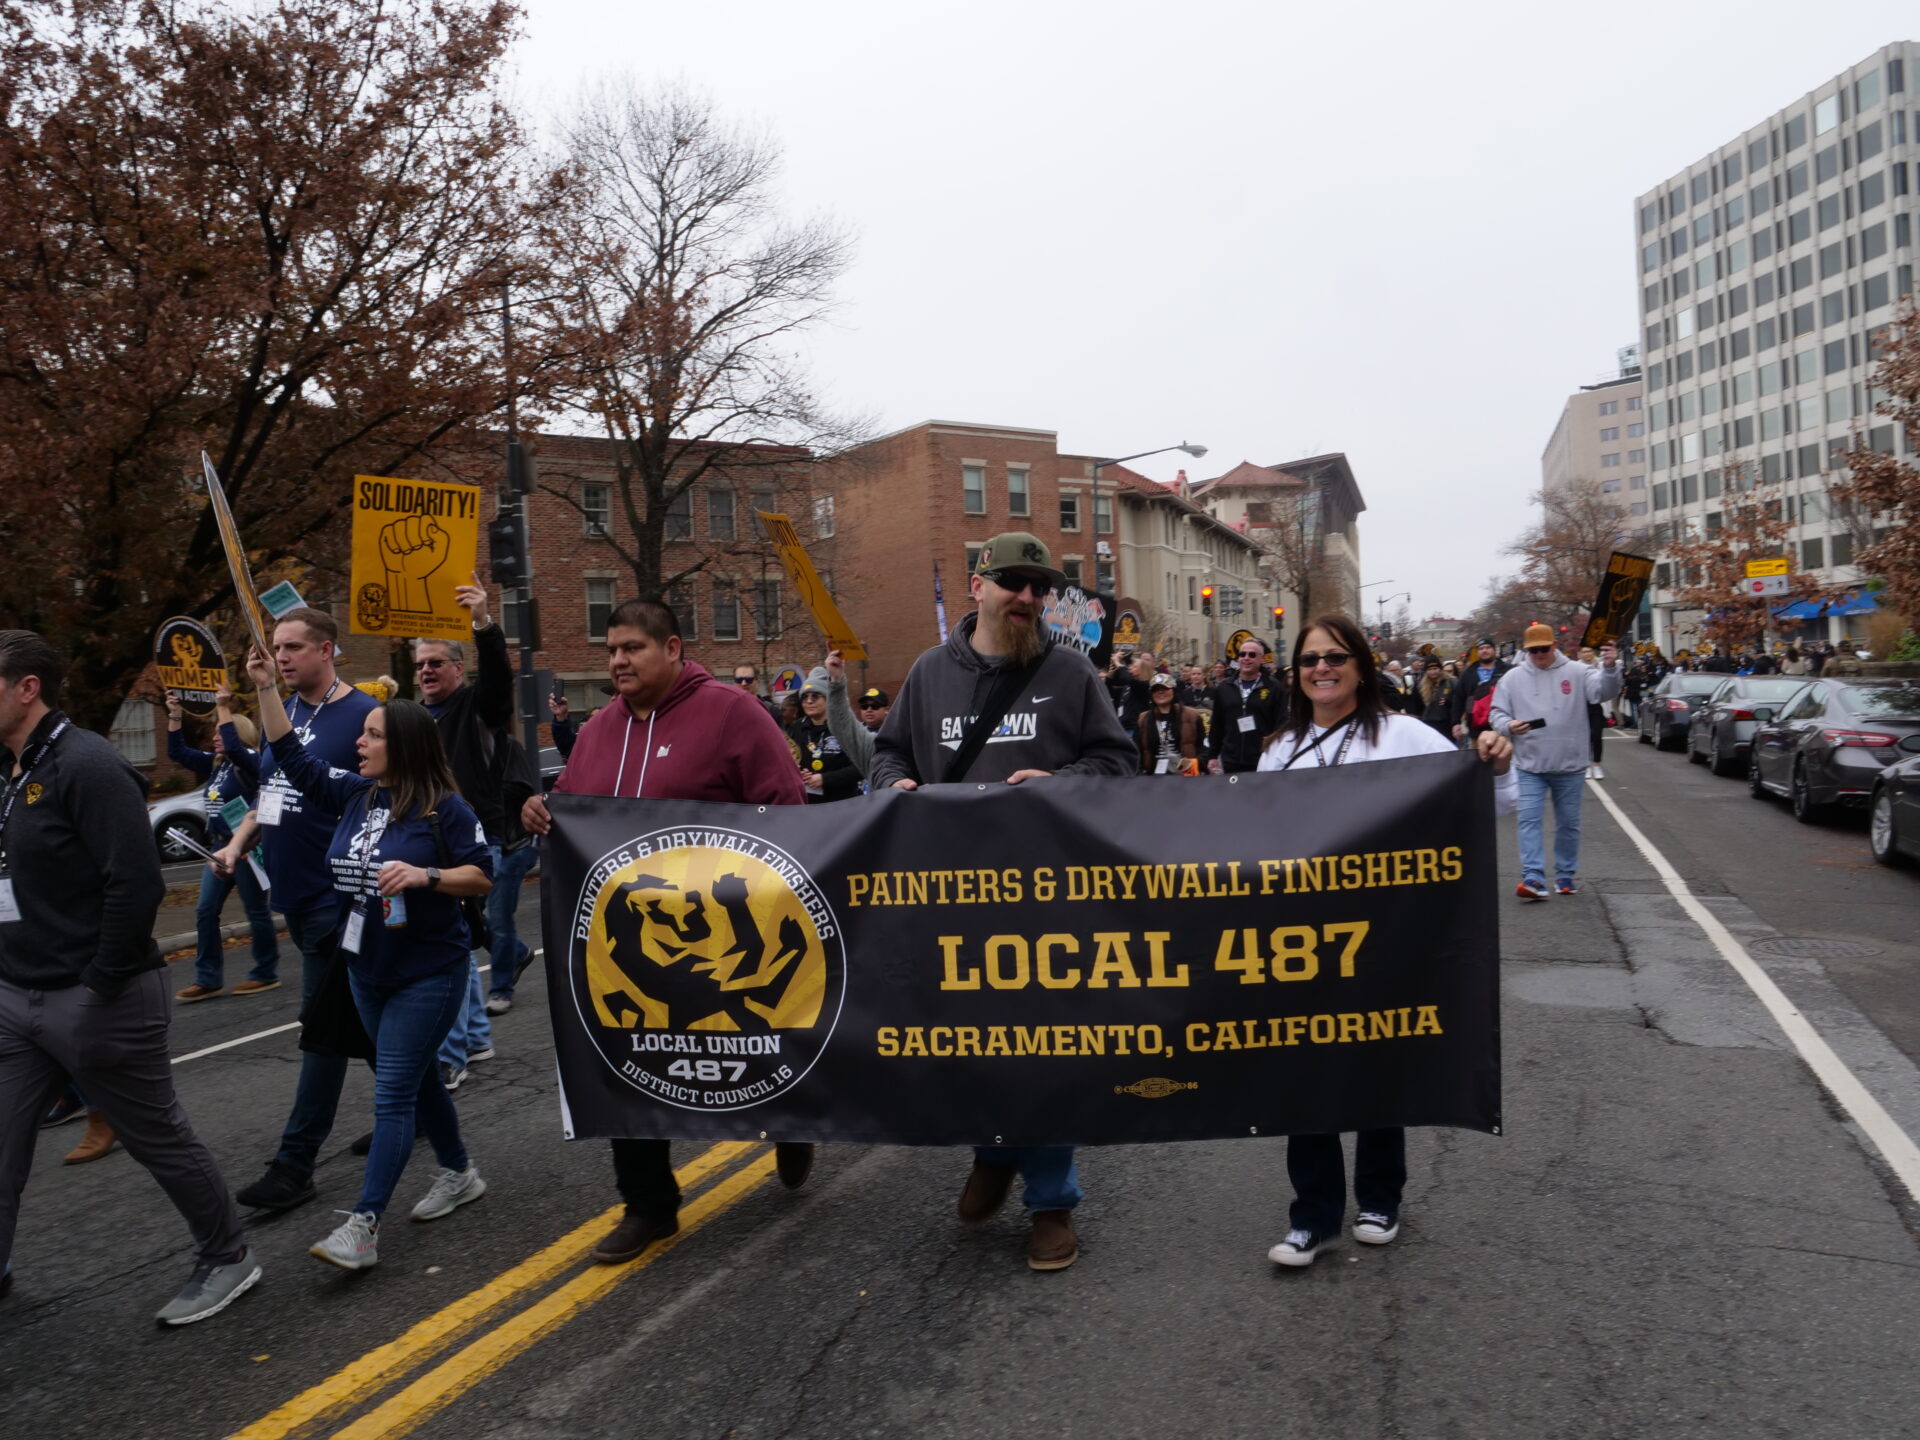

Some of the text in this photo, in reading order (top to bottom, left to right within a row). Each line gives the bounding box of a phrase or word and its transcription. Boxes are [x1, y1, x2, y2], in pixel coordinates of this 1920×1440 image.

[360, 481, 476, 519] SOLIDARITY!
[158, 666, 222, 688] WOMEN
[576, 831, 835, 943] PAINTERS & DRYWALL FINISHERS
[847, 846, 1464, 907] PAINTERS & DRYWALL FINISHERS
[938, 920, 1371, 991] LOCAL 487
[631, 1033, 782, 1055] LOCAL UNION
[876, 1005, 1444, 1059] SACRAMENTO, CALIFORNIA
[621, 1059, 794, 1106] DISTRICT COUNCIL 16
[667, 1059, 748, 1083] 487
